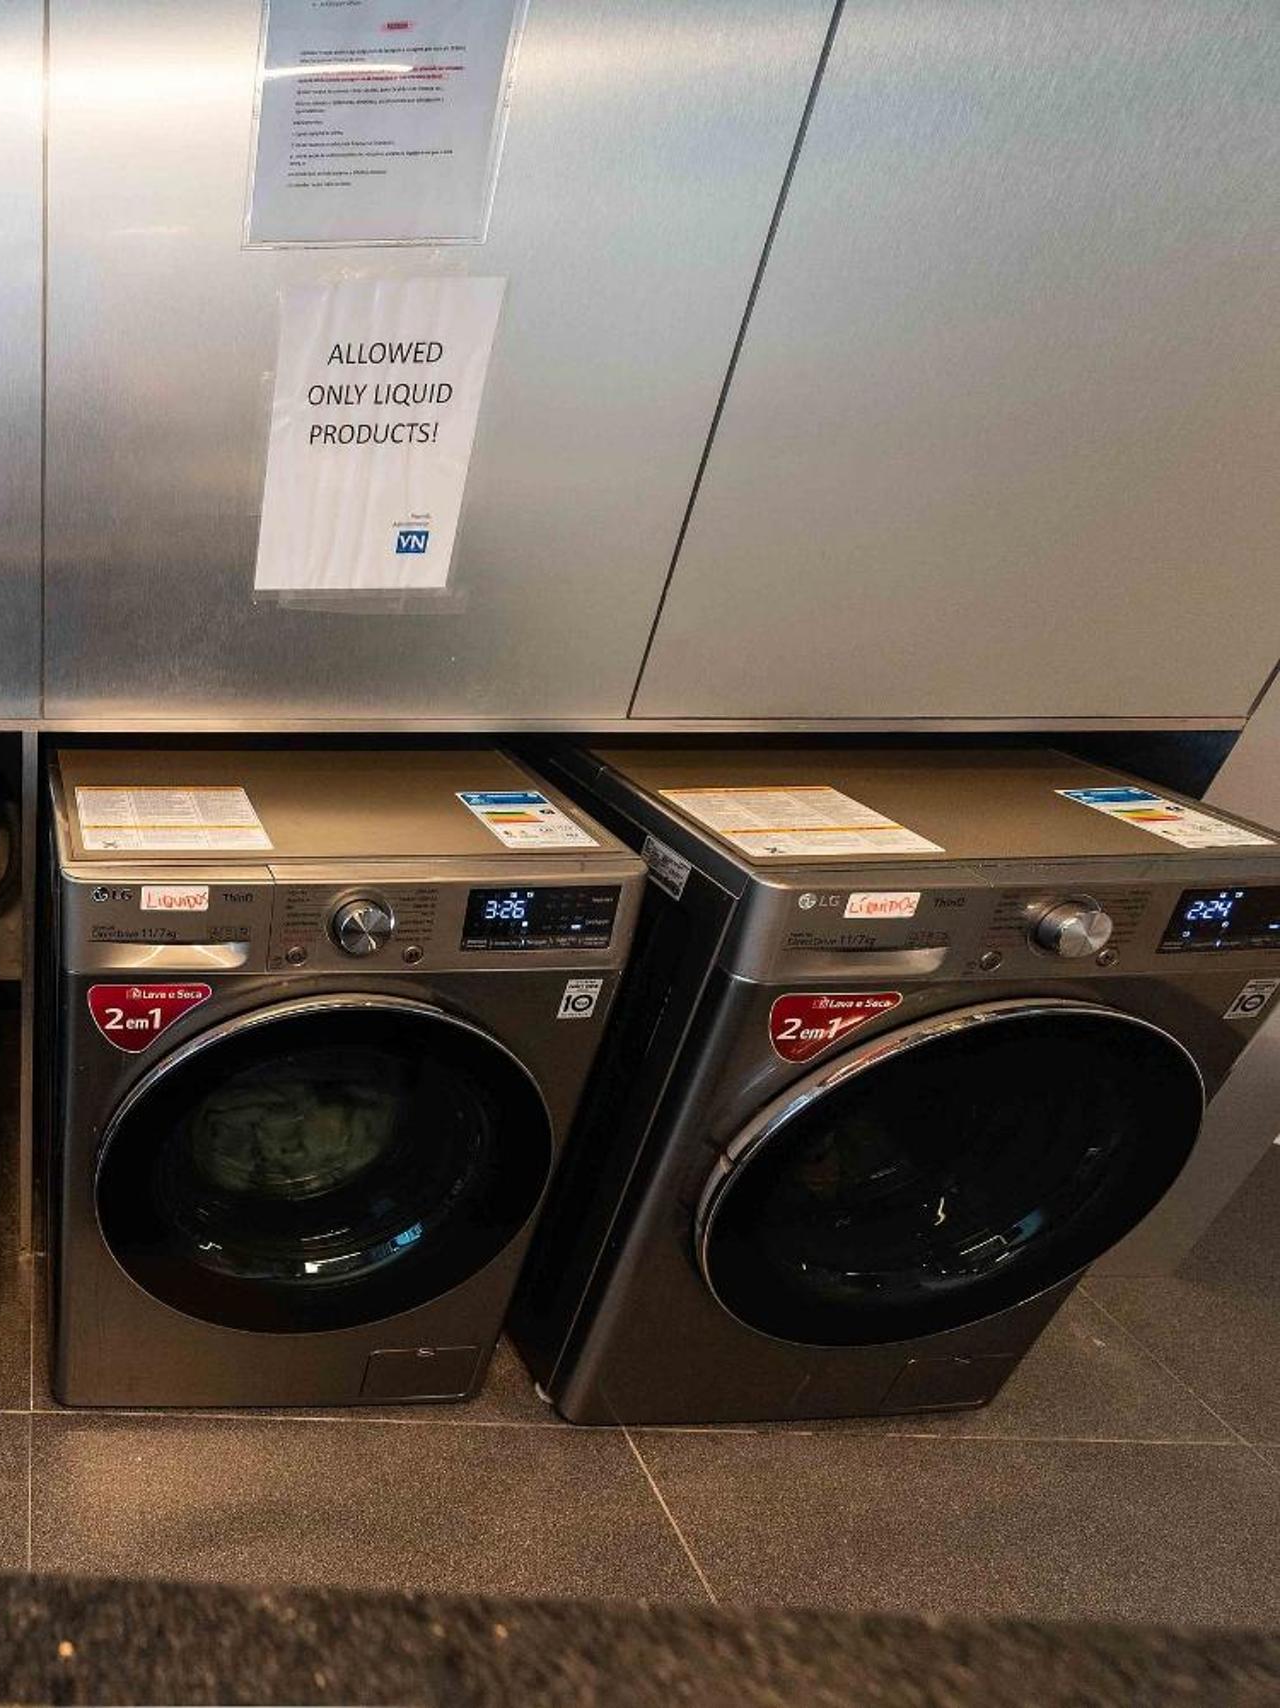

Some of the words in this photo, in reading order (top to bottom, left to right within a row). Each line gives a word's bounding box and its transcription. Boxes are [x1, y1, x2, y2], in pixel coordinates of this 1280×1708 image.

[327, 342, 443, 365] ALLOWED
[308, 384, 367, 406] ONLY
[373, 383, 453, 407] LIQUID
[309, 422, 439, 446] PRODUCTS!
[400, 535, 426, 550] VN
[485, 900, 526, 919] 3:26
[1186, 901, 1233, 920] 2:24
